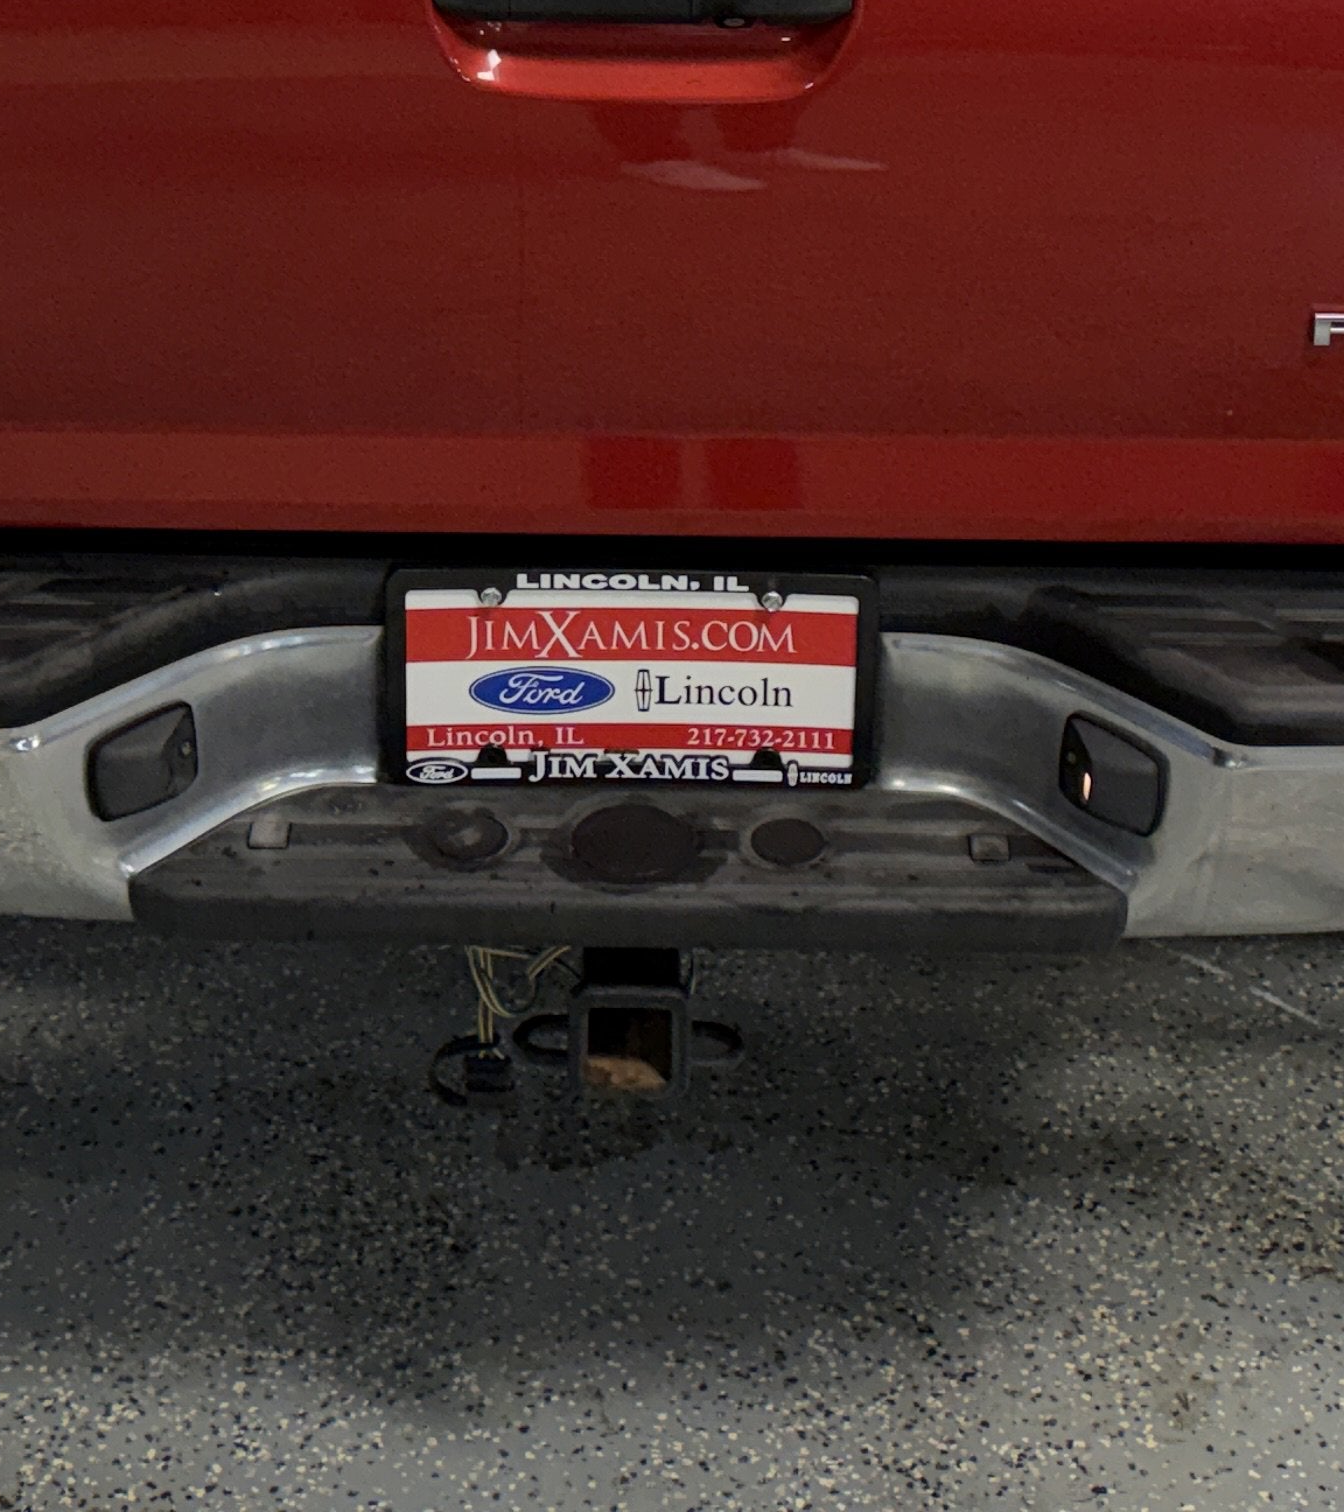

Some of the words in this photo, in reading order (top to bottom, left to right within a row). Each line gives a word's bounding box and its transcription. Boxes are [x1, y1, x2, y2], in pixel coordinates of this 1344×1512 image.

[714, 575, 749, 592] IL
[466, 611, 797, 659] JIMXAMIS.COM
[499, 673, 584, 706] Ford
[655, 675, 794, 707] Lincoln
[427, 726, 543, 747] Lincoln,
[556, 729, 584, 745] IL
[687, 728, 835, 749] 217-732-2111
[529, 751, 597, 782] JIM
[605, 753, 729, 781] XAMIS
[799, 772, 853, 785] LINCOLN
